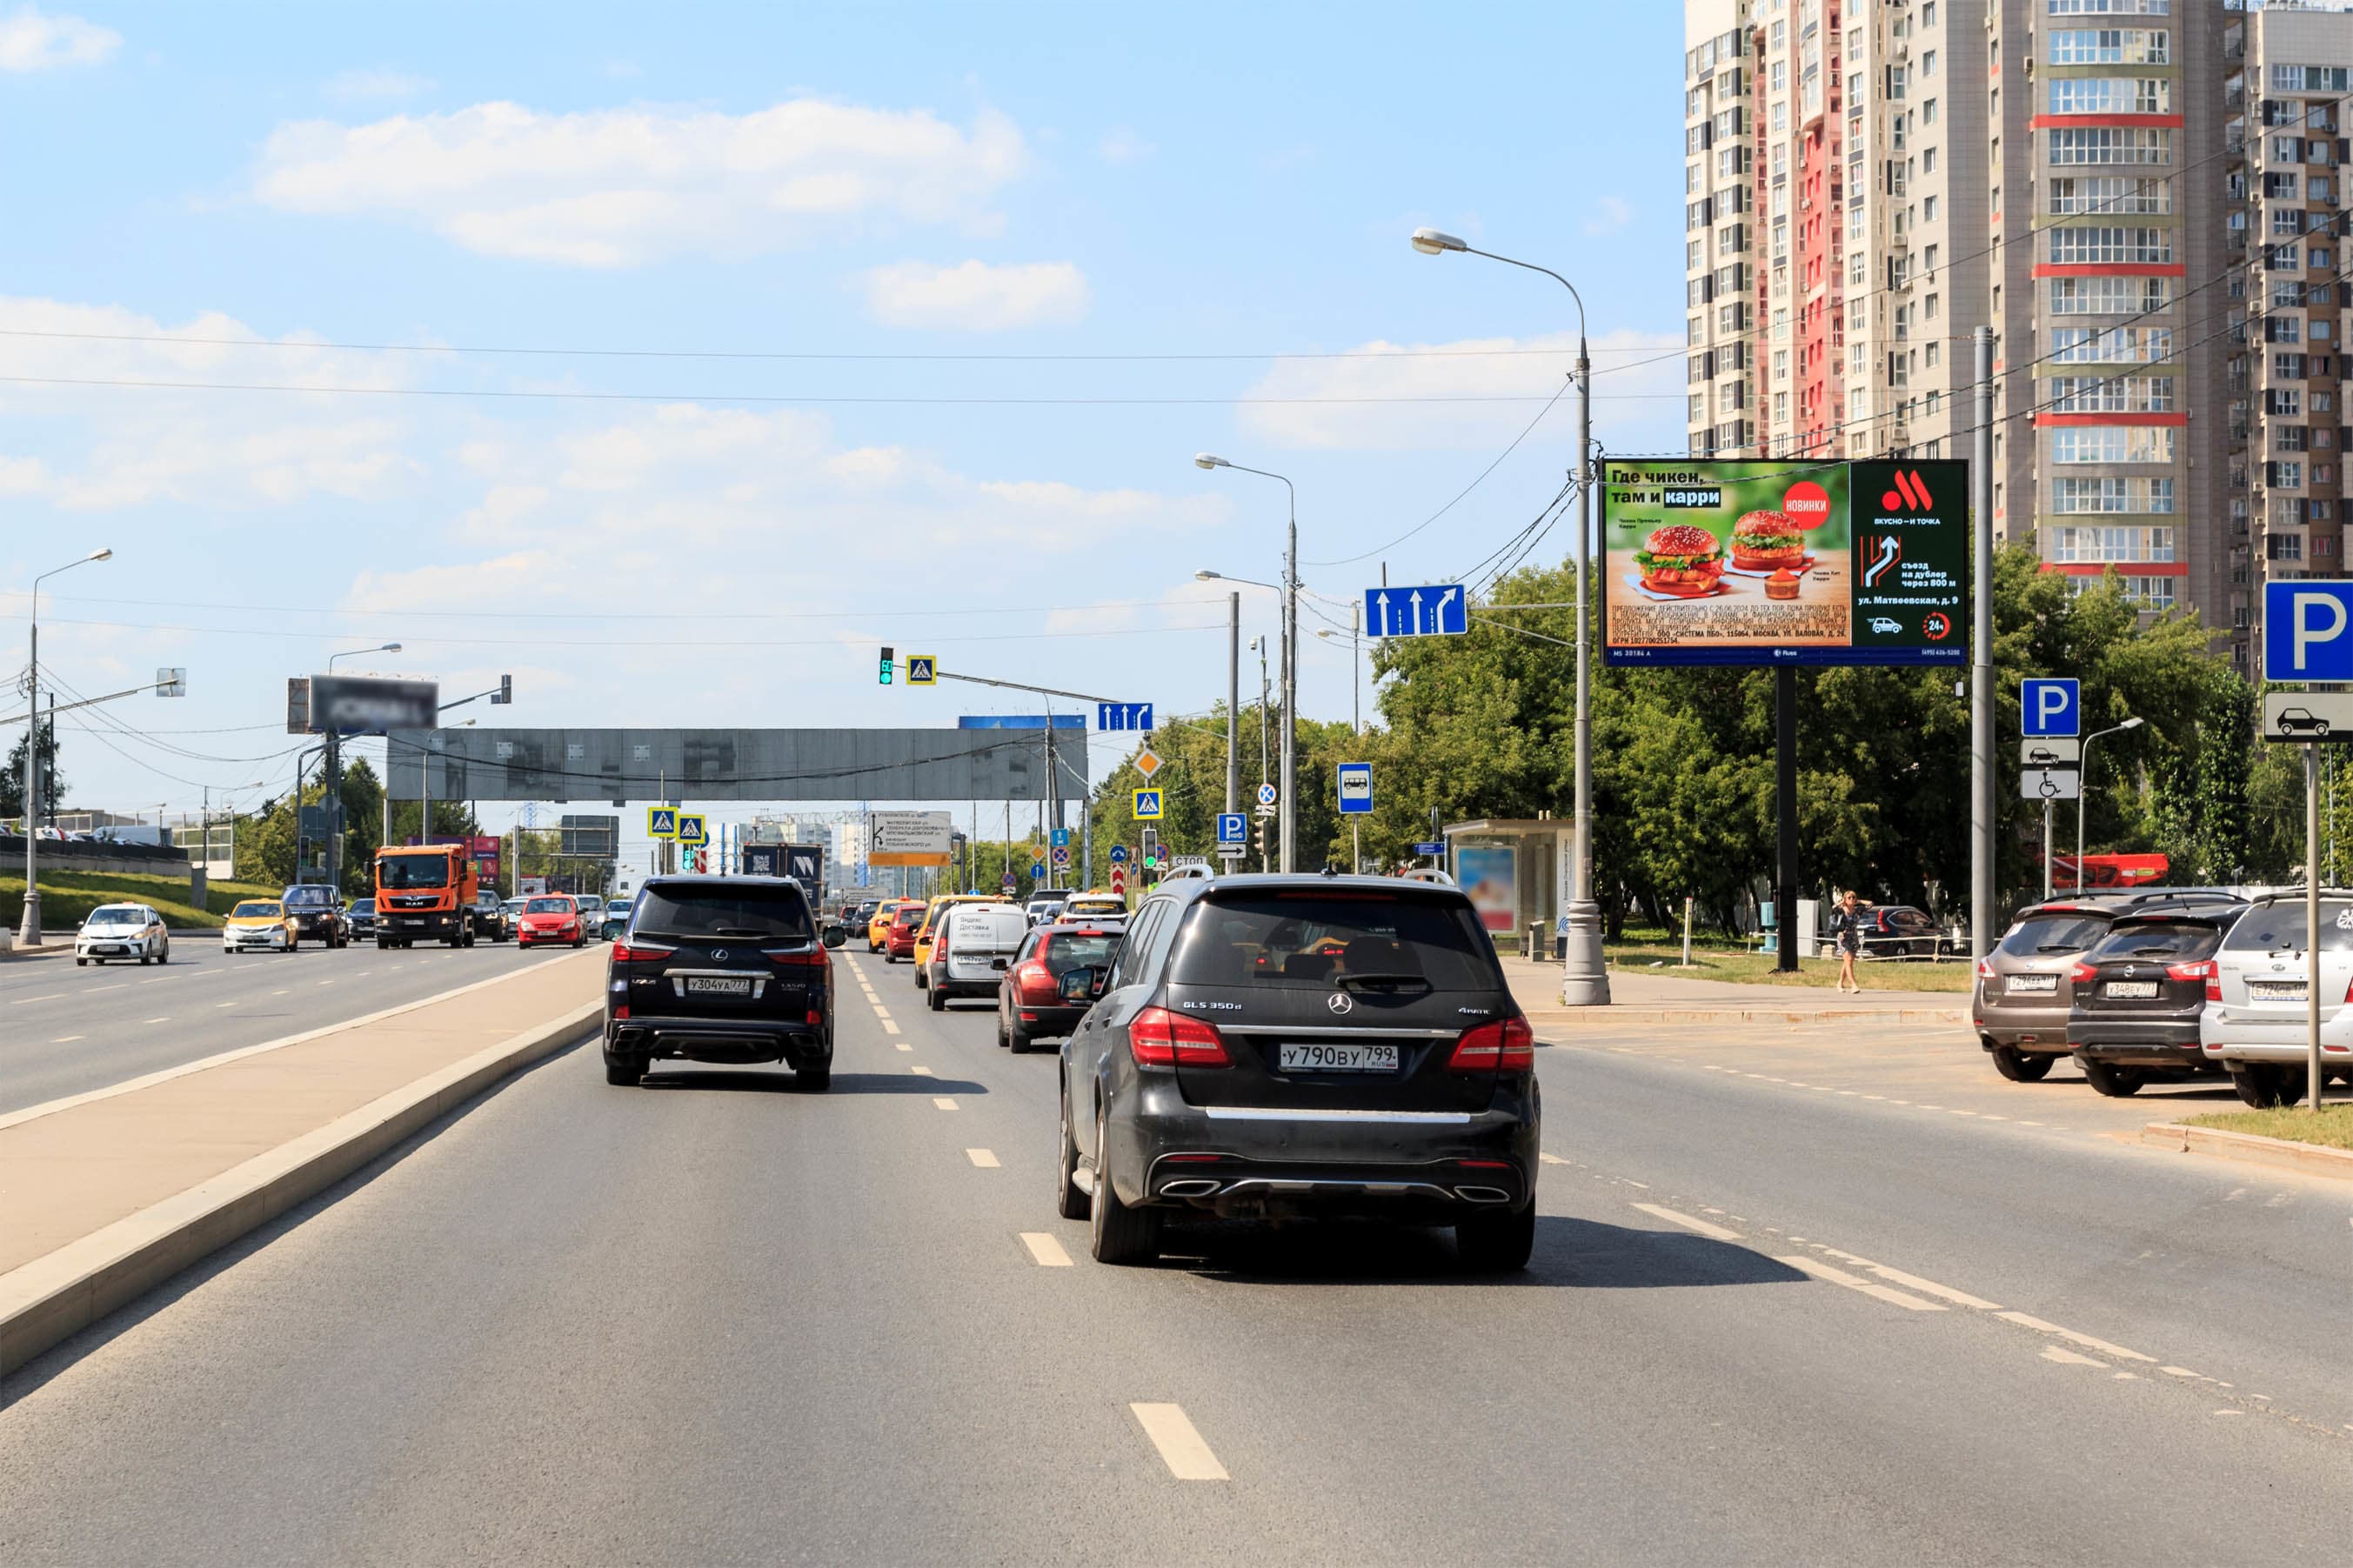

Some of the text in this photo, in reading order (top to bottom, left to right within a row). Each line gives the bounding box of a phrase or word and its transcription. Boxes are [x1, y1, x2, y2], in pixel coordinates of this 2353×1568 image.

[1612, 470, 1704, 485] Где чикен,
[1611, 491, 1720, 506] там и карри
[1786, 500, 1827, 512] НОВИНКИ
[1915, 570, 1947, 580] дублер
[1874, 597, 1940, 606] Матвеевская,
[1176, 857, 1203, 866] СТОП
[1287, 1046, 1393, 1065] У790ВУ 799
